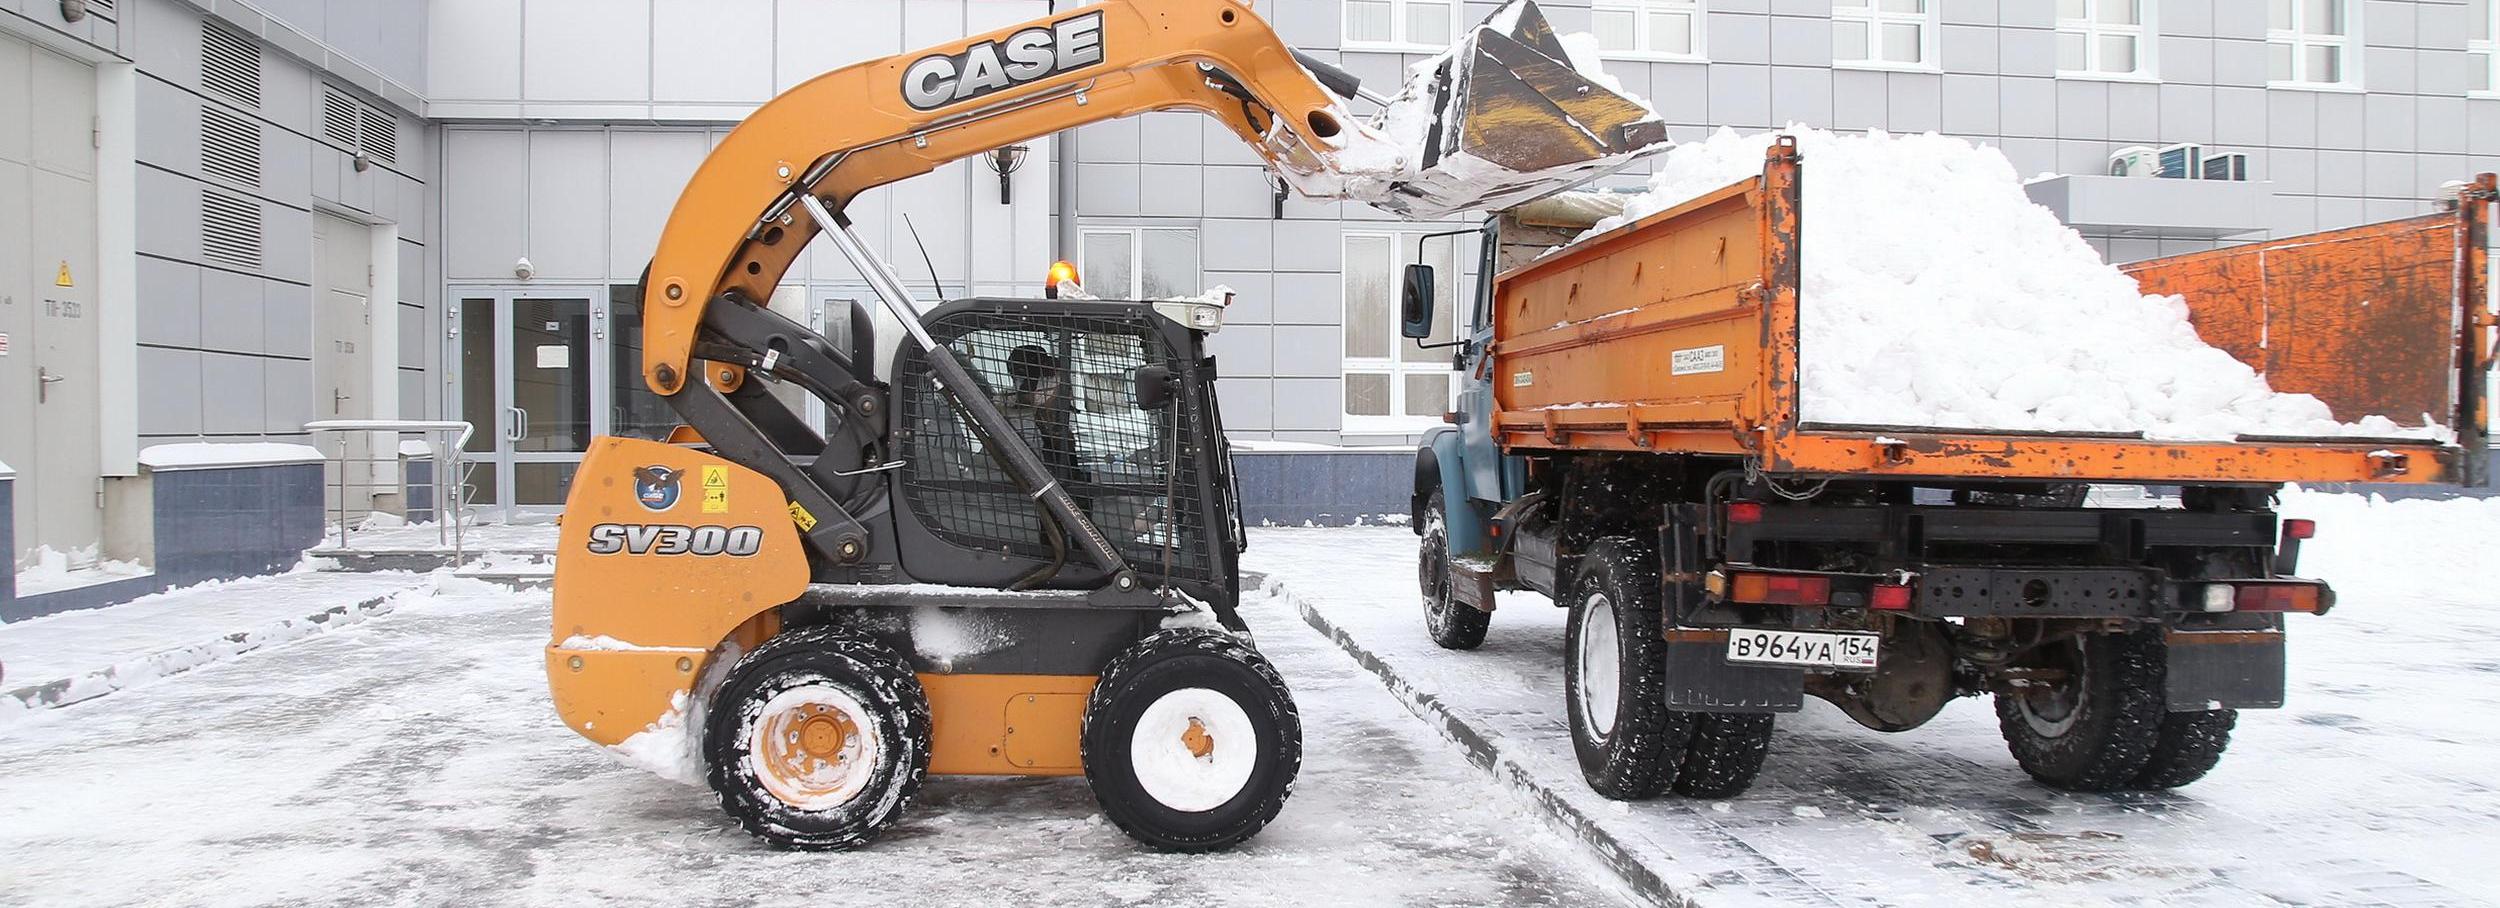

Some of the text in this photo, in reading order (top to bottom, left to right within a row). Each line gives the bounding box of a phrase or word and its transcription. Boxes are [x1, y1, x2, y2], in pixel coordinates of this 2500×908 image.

[902, 11, 1103, 109] CASE
[587, 522, 763, 556] SV300
[1838, 637, 1875, 656] 154
[1843, 656, 1862, 664] RUS
